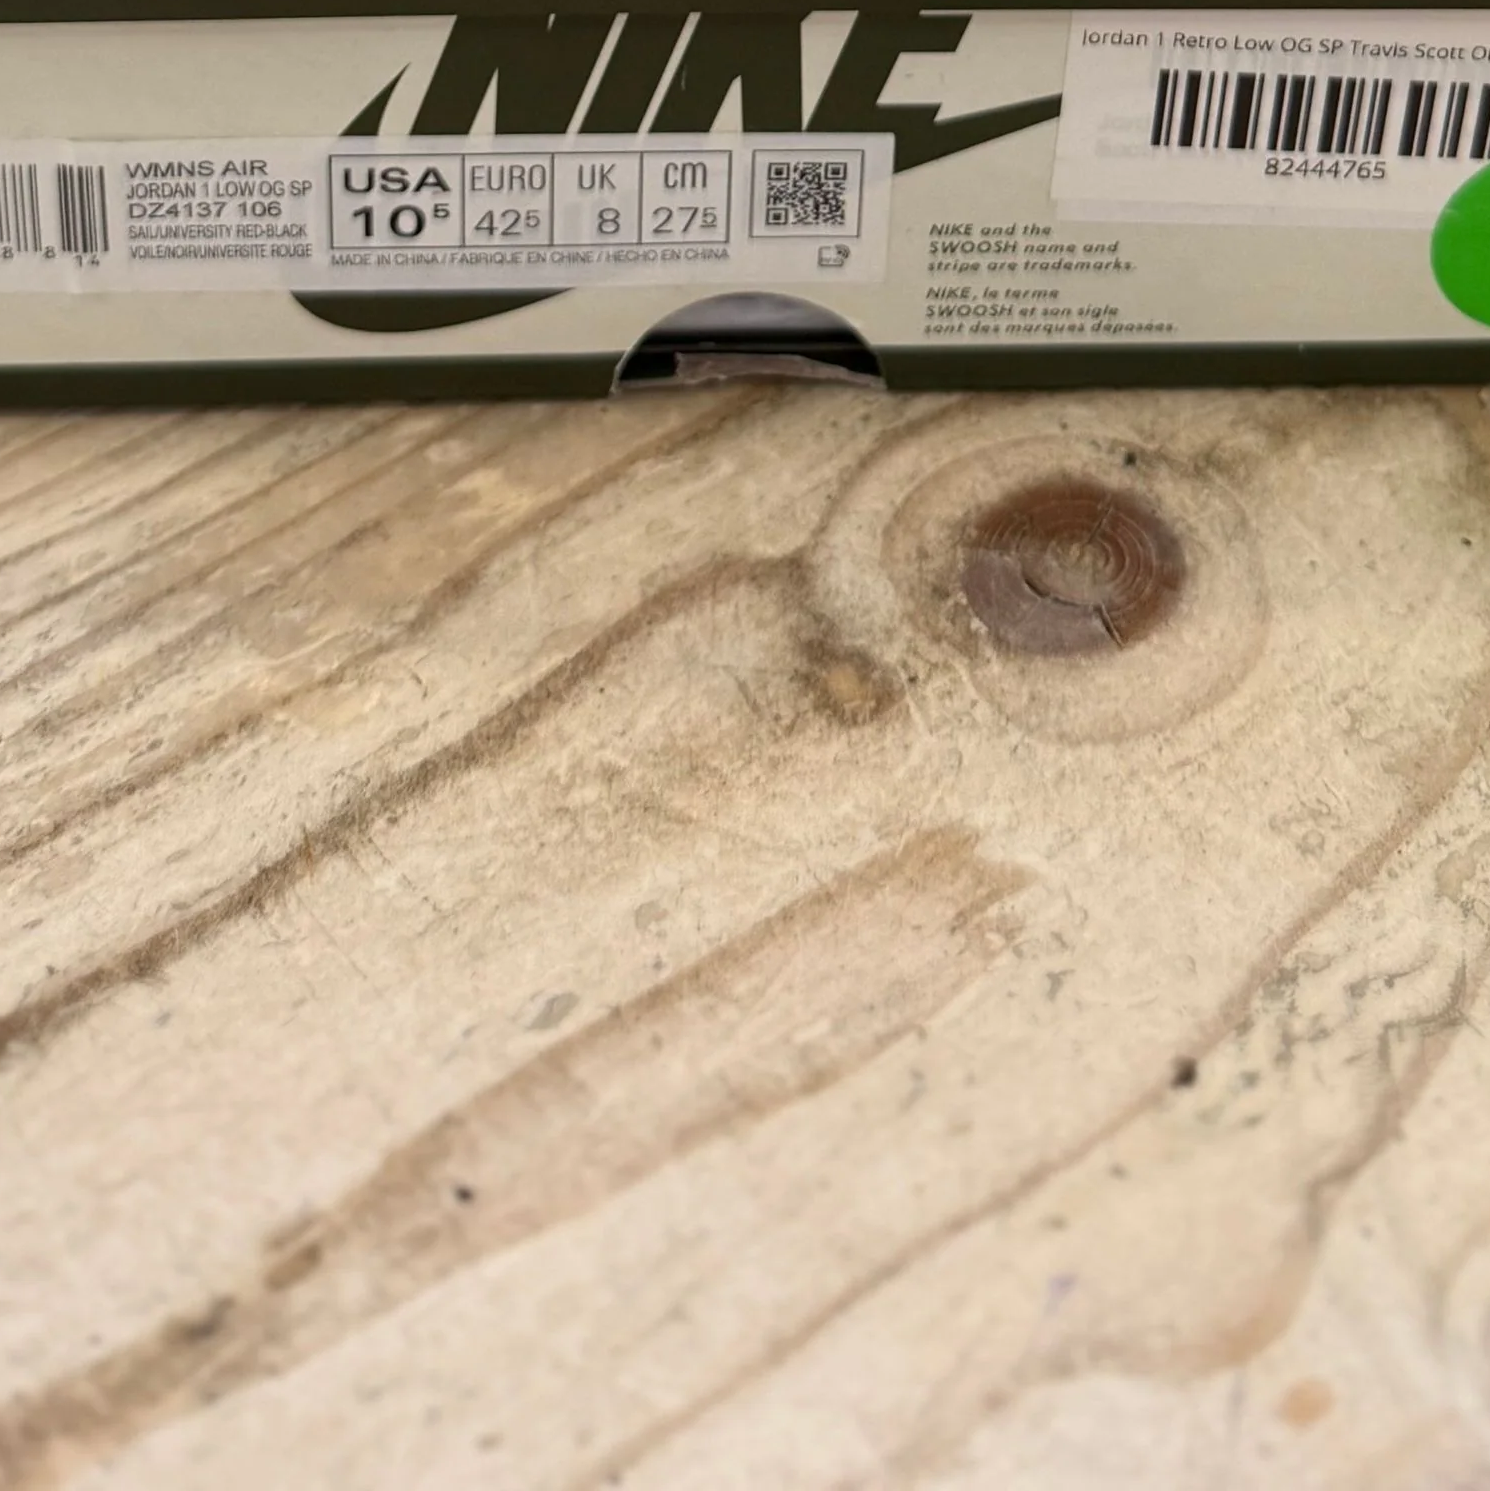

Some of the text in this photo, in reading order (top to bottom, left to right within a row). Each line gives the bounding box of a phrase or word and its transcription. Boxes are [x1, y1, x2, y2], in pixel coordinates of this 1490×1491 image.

[1082, 29, 1148, 47] Jordan
[1157, 31, 1164, 47] 1
[1172, 32, 1227, 51] Retro
[1234, 35, 1275, 53] Low
[1280, 37, 1312, 54] OG
[1317, 38, 1343, 55] SP
[1351, 39, 1408, 59] Travis
[1414, 43, 1465, 61] Scott
[126, 159, 269, 179] WMNS AIR
[1265, 158, 1386, 180] 82444765
[343, 166, 451, 193] USA
[470, 164, 546, 191] EURO
[577, 163, 617, 190] UK
[126, 179, 312, 200] JORDAN 1 LOW OG SP
[129, 201, 283, 219] DZ4137 106
[597, 207, 621, 235] 8
[929, 222, 1052, 237] NIKE and the
[236, 223, 308, 240] RED-BLACK
[44, 245, 57, 259] 8
[271, 242, 313, 259] ROUGE
[929, 240, 1120, 254] SWOOSH name and
[74, 254, 101, 268] 14
[331, 253, 372, 267] MADE
[377, 252, 393, 265] IN
[395, 251, 439, 265] CHINA
[450, 250, 523, 265] FABRIQUE
[527, 250, 547, 265] EN
[550, 250, 595, 264] CHINE
[605, 249, 658, 263] HECHO
[661, 248, 681, 262] EN
[684, 247, 730, 260] CHINA
[927, 259, 980, 274] stripe
[987, 261, 1017, 272] are
[926, 286, 1060, 301] NIKE, le terme
[926, 304, 1118, 319] SWOOSH et son sigle
[924, 322, 964, 335] sont
[969, 321, 1000, 334] des
[1005, 322, 1086, 337] marques
